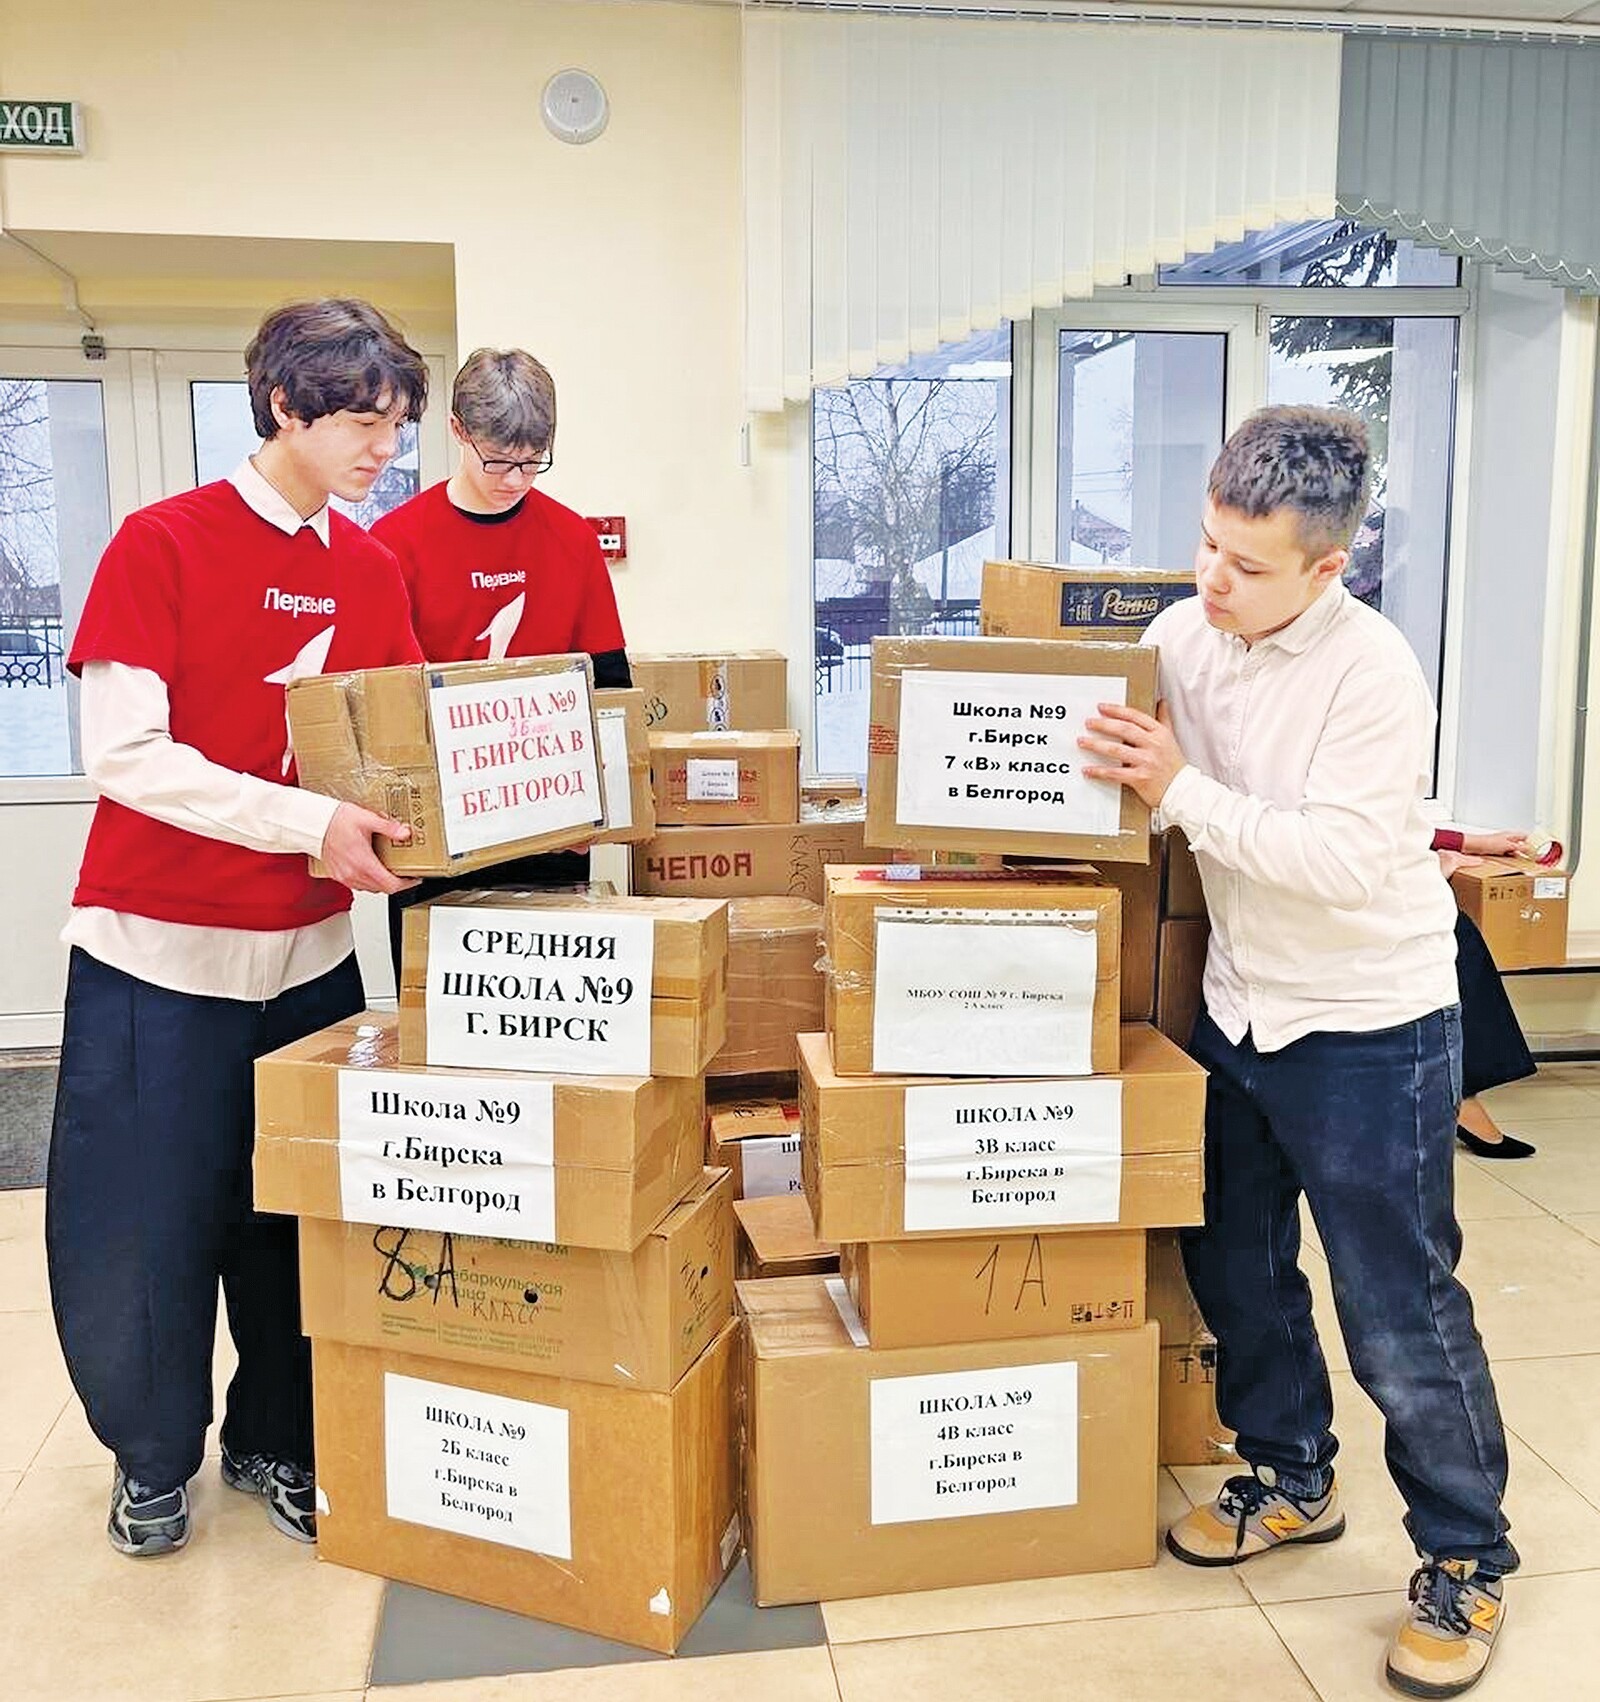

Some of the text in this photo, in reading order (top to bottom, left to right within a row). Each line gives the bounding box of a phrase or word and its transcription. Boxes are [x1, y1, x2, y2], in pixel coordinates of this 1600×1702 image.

[0, 105, 68, 143] ХОД
[471, 570, 526, 591] Первые
[264, 587, 336, 618] Первые
[449, 688, 577, 730] ШКОЛА №9
[953, 701, 1067, 720] Школа №9
[968, 728, 1049, 748] г.Бирск
[452, 729, 585, 774] Г.БИРСКА В
[944, 755, 1071, 775] 7 «В» класс
[461, 770, 586, 817] БЕЛГОРОД
[948, 784, 1065, 805] в Белгород
[462, 929, 617, 960] СРЕДНЯЯ
[442, 972, 634, 1005] ШКОЛА №9
[907, 988, 946, 999] МБОУ
[949, 989, 981, 999] СОШ
[1022, 990, 1064, 1001] Бирска
[466, 1012, 609, 1042] Г. БИРСК
[371, 1091, 521, 1125] Школа №9
[956, 1104, 1074, 1125] ШКОЛА №9
[382, 1136, 503, 1168] г.Бирска
[781, 1141, 801, 1153] Ш
[974, 1138, 1056, 1155] 3В класс
[966, 1165, 1064, 1182] г.Бирска в
[372, 1178, 521, 1213] в Белгород
[971, 1189, 1056, 1205] Белгород
[472, 1299, 541, 1325] КЛАСС
[919, 1389, 1033, 1415] ШКОЛА №9
[426, 1406, 526, 1441] ШКОЛА №9
[937, 1423, 1015, 1441] 4В класс
[441, 1438, 510, 1467] 2Б класс
[929, 1450, 1023, 1470] г.Бирска в
[434, 1468, 518, 1497] г.Бирска в
[935, 1476, 1017, 1495] Белгород
[440, 1492, 514, 1523] Белгород
